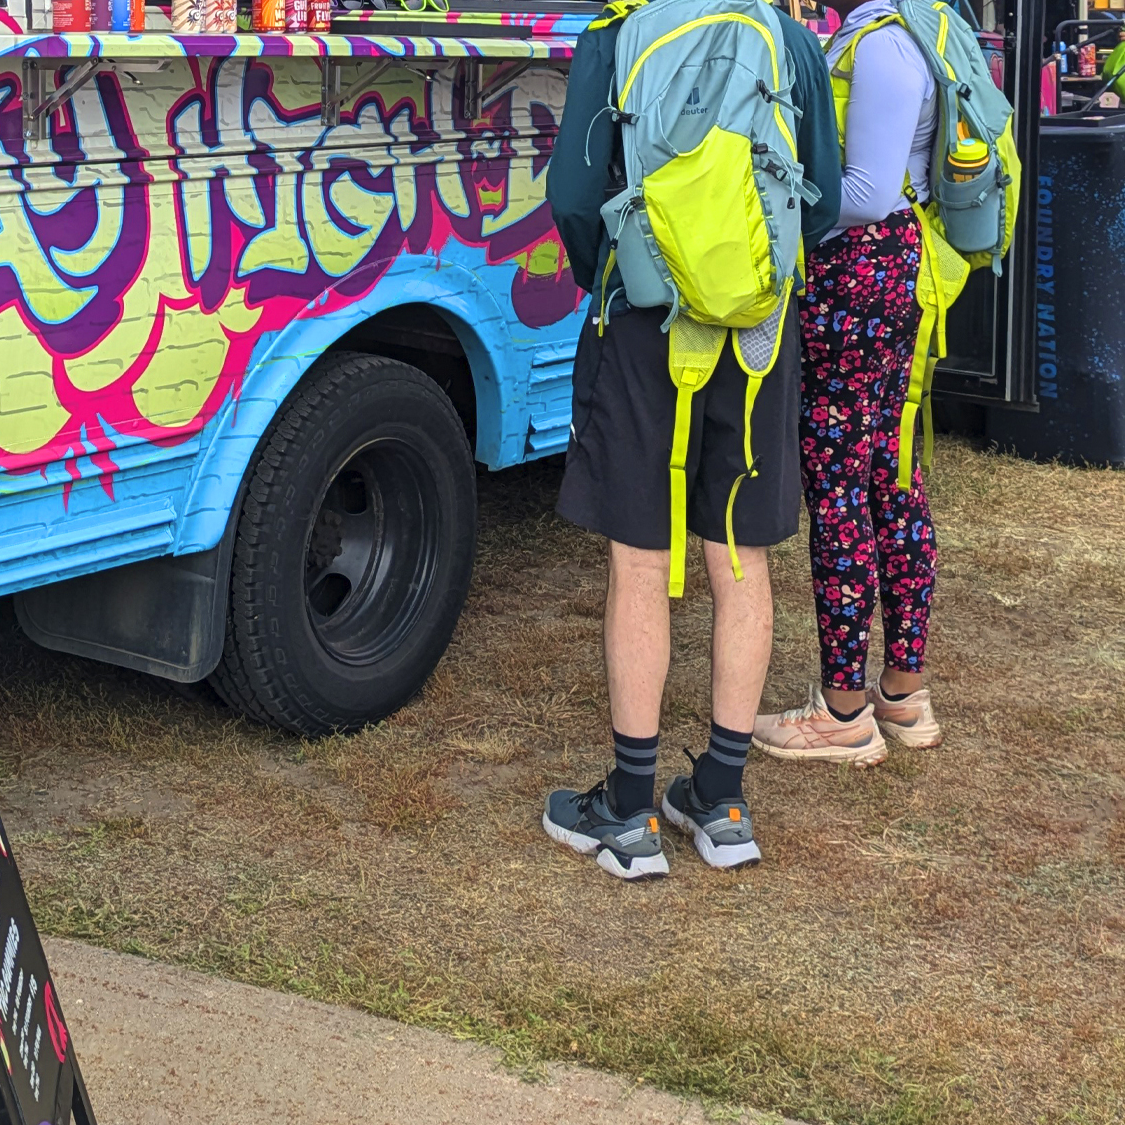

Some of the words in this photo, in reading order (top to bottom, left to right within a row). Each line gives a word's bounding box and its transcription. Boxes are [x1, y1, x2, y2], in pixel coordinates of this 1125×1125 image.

[680, 107, 709, 116] deuter
[1036, 175, 1055, 296] FOUNDRY
[1037, 303, 1059, 399] NATION
